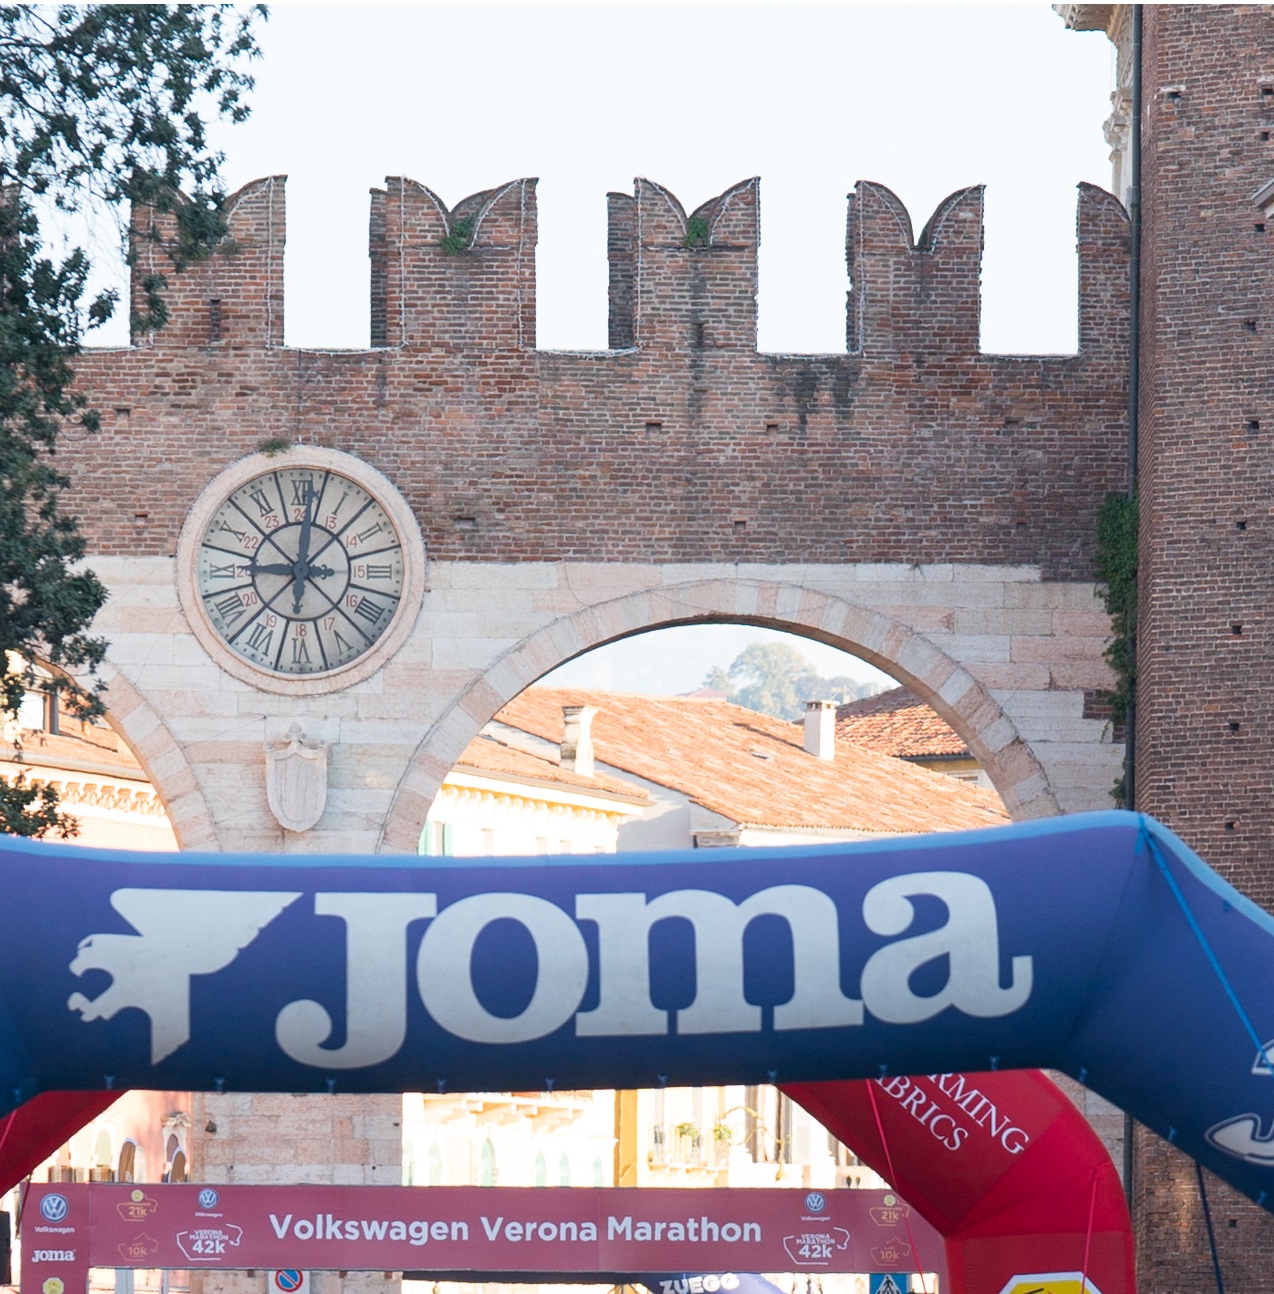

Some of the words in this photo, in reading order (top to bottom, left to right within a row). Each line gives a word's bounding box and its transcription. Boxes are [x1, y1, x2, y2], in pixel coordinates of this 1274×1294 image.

[264, 515, 280, 528] 23
[325, 516, 337, 529] 13
[244, 537, 259, 549] 22
[346, 536, 358, 548] 14
[353, 565, 365, 578] 15
[243, 592, 258, 606] 20
[346, 595, 358, 608] 16
[265, 615, 277, 628] 19
[323, 617, 335, 631] 17
[295, 624, 307, 637] 18
[129, 1206, 147, 1216] 21k
[881, 1211, 899, 1220] 21k
[34, 1226, 75, 1235] Volkswagen
[269, 1213, 469, 1246] Volkswagen
[480, 1216, 598, 1243] Verona
[608, 1216, 762, 1243] Marathon
[192, 1240, 225, 1254] 42k
[798, 1244, 832, 1258] 42k
[880, 1250, 899, 1259] 10k
[659, 1272, 740, 1294] ZUEGG
